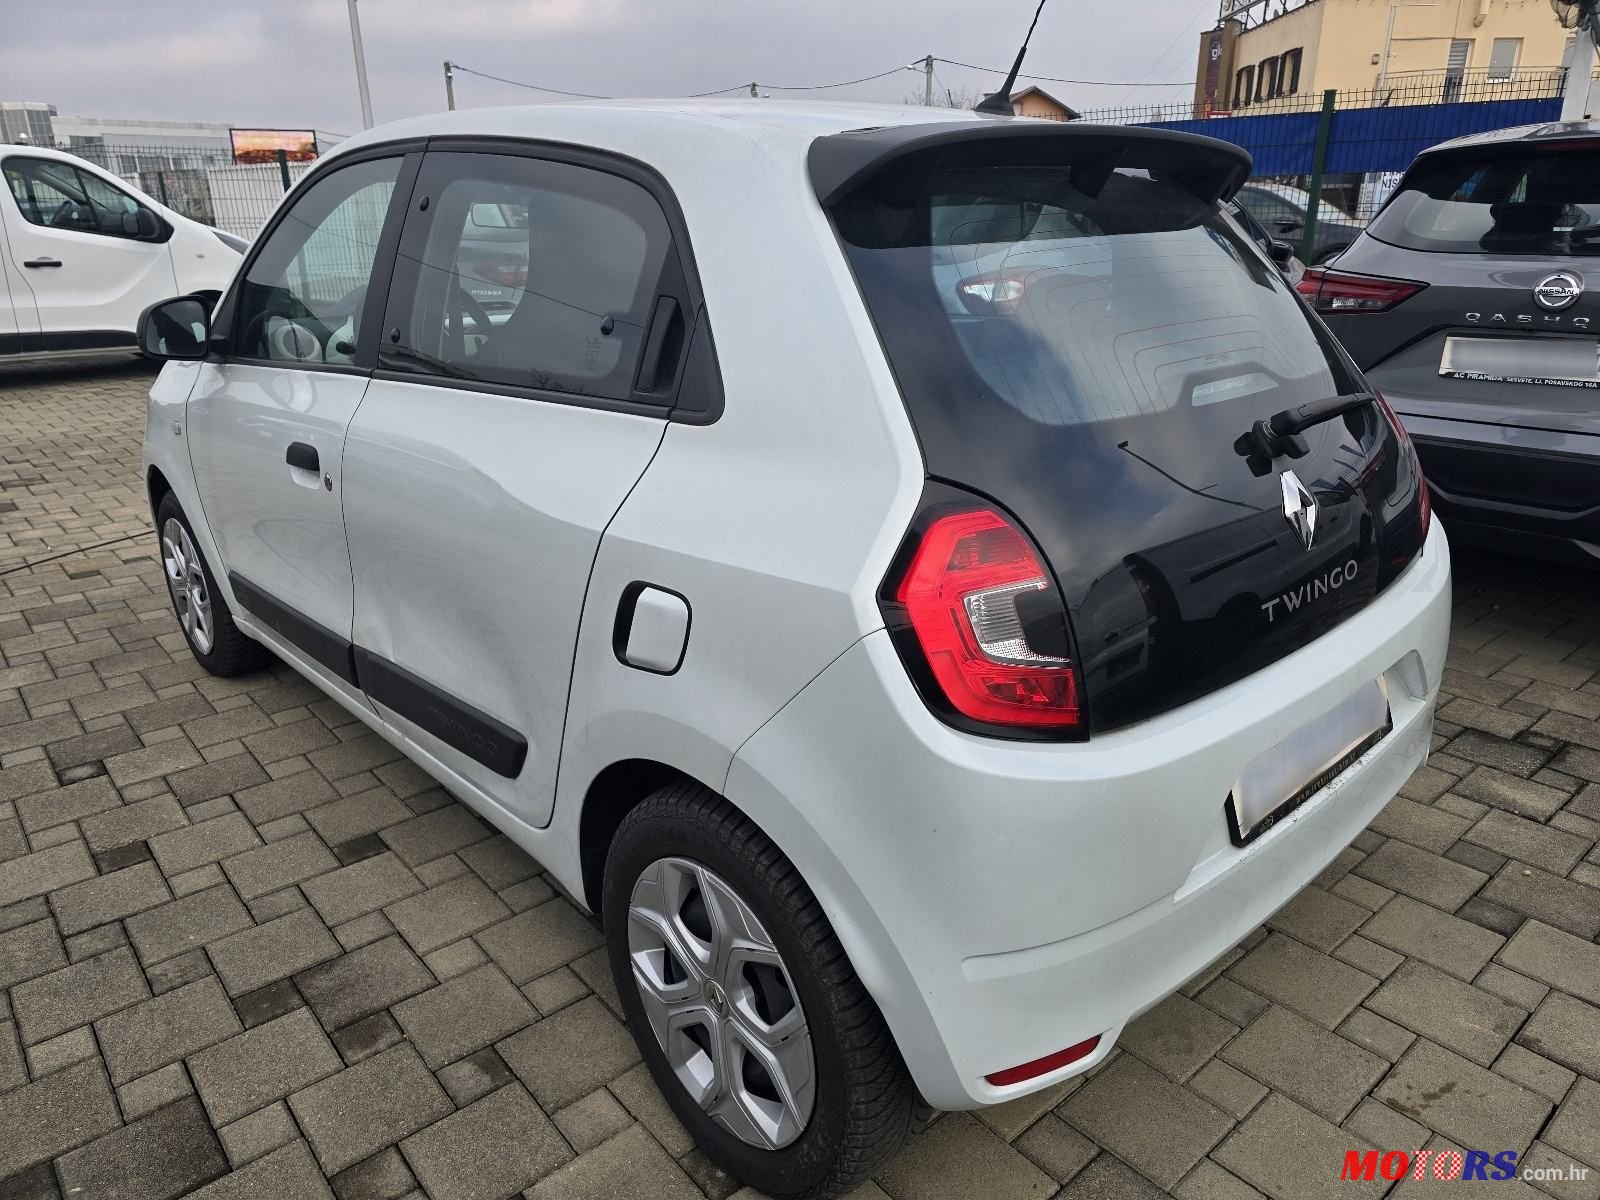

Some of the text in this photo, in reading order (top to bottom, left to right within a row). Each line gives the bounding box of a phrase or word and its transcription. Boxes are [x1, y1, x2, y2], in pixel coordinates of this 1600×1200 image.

[1537, 287, 1575, 296] NISSAN
[1465, 312, 1590, 328] QASHQ
[1261, 559, 1358, 622] TWINGO
